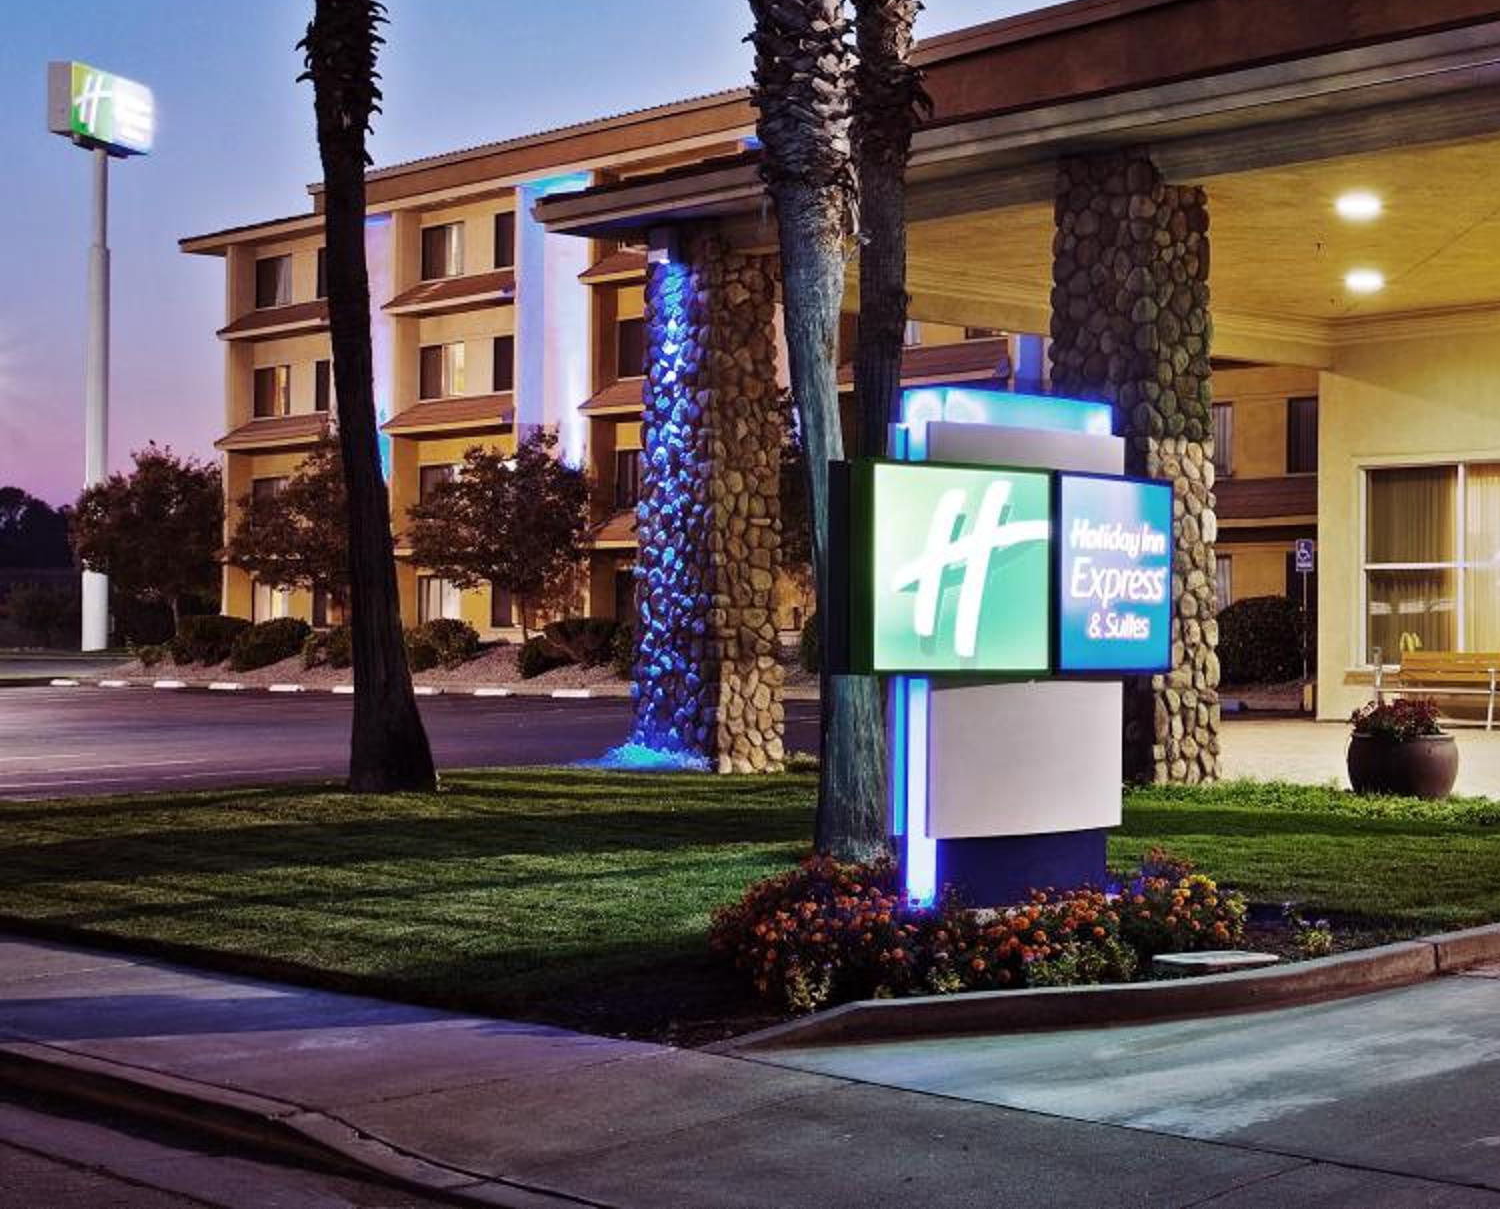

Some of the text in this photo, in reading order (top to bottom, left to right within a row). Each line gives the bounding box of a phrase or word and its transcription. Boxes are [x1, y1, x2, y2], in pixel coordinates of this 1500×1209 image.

[1070, 518, 1165, 559] Holiday Inn
[1071, 556, 1166, 608] Express
[1088, 612, 1150, 639] & Suites
